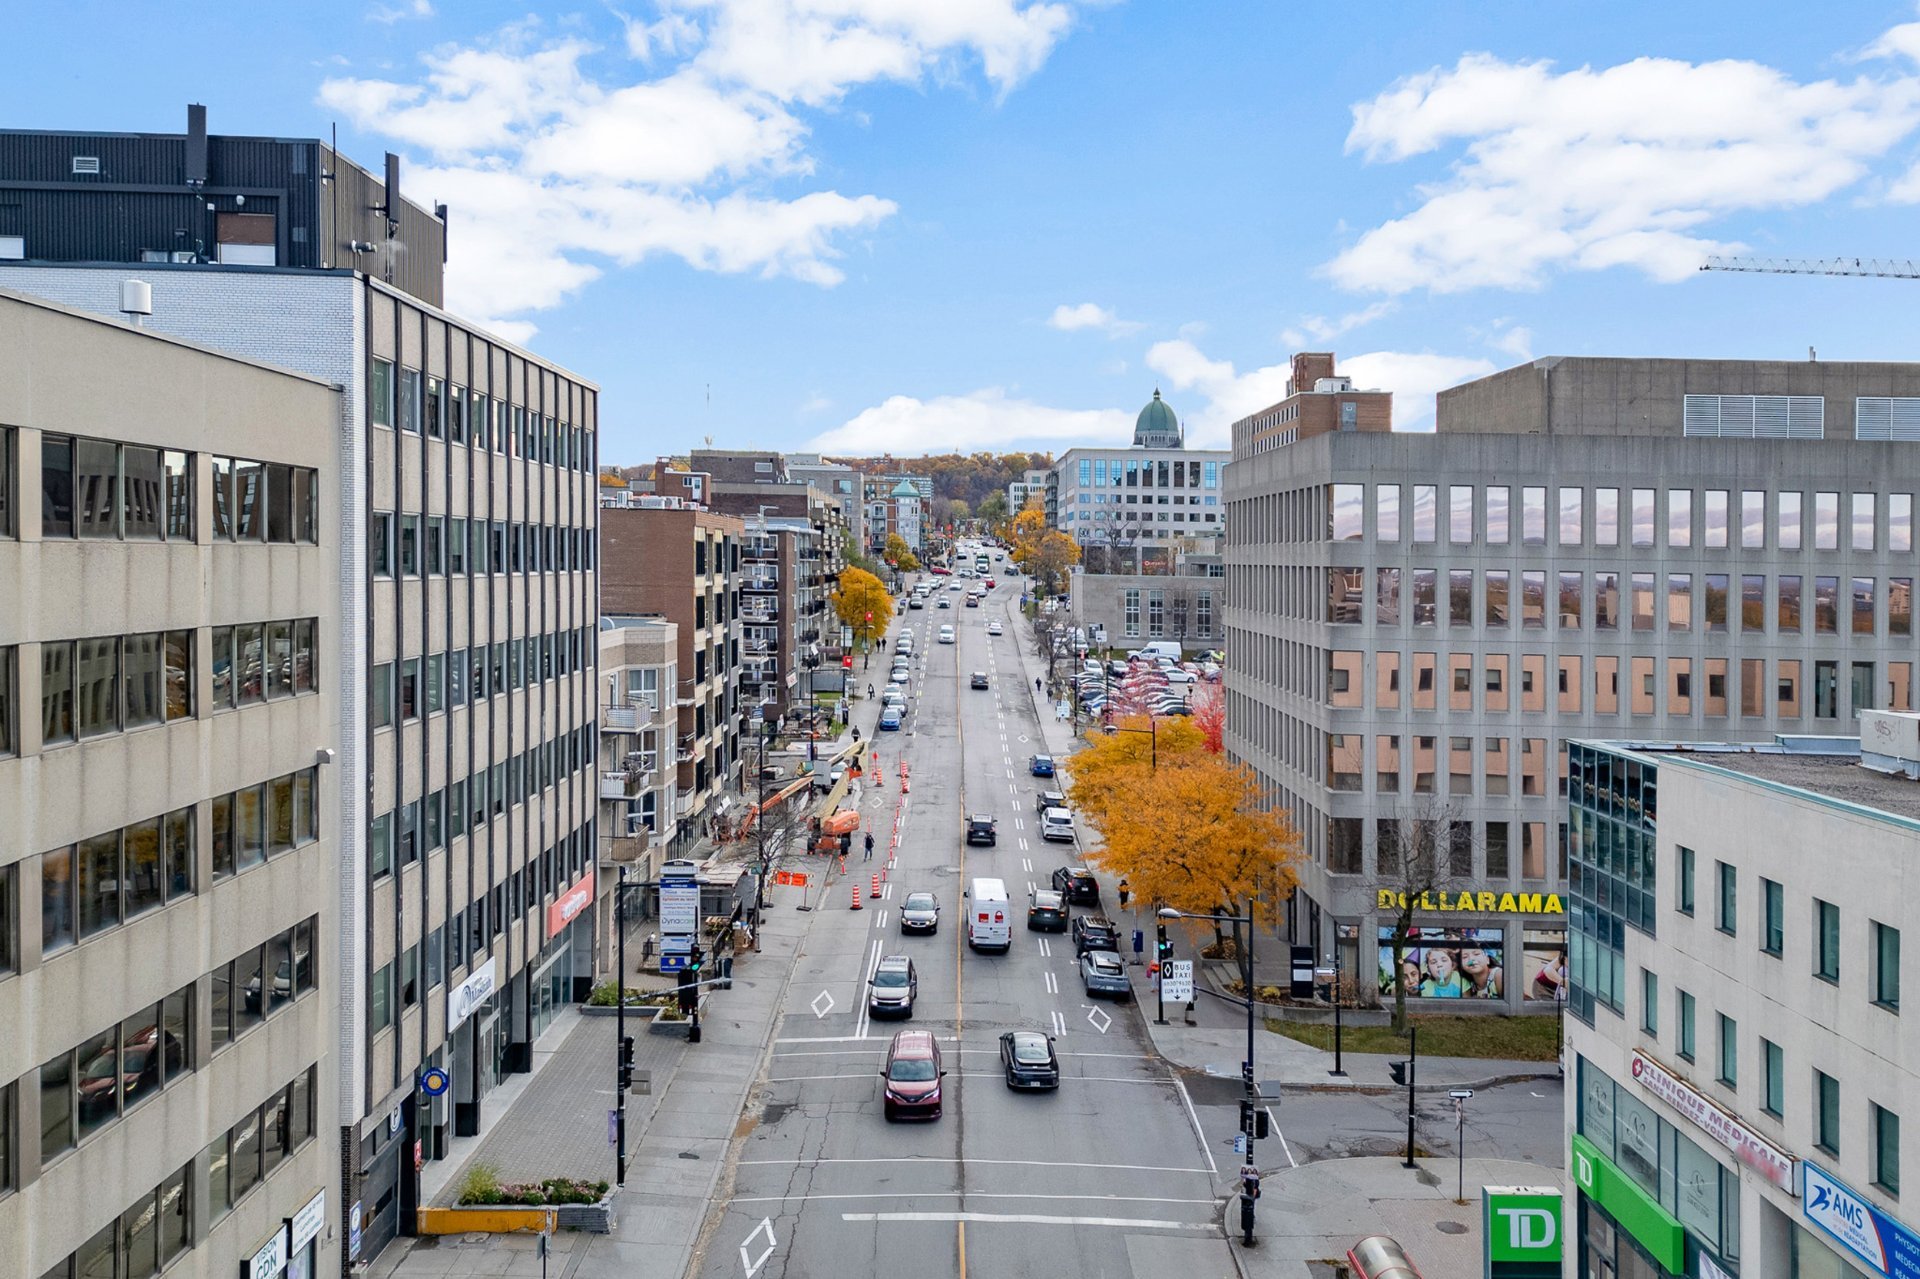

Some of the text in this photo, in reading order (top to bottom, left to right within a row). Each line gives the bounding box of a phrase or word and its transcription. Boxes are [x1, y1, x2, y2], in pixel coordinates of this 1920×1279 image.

[1377, 889, 1564, 914] DOLLARAMA
[1642, 1063, 1705, 1115] CLINIQUE
[1643, 1076, 1664, 1097] SANS
[1576, 1151, 1593, 1187] TD
[1497, 1208, 1556, 1248] TD
[1833, 1193, 1863, 1230] AMS
[256, 1250, 277, 1279] CDN
